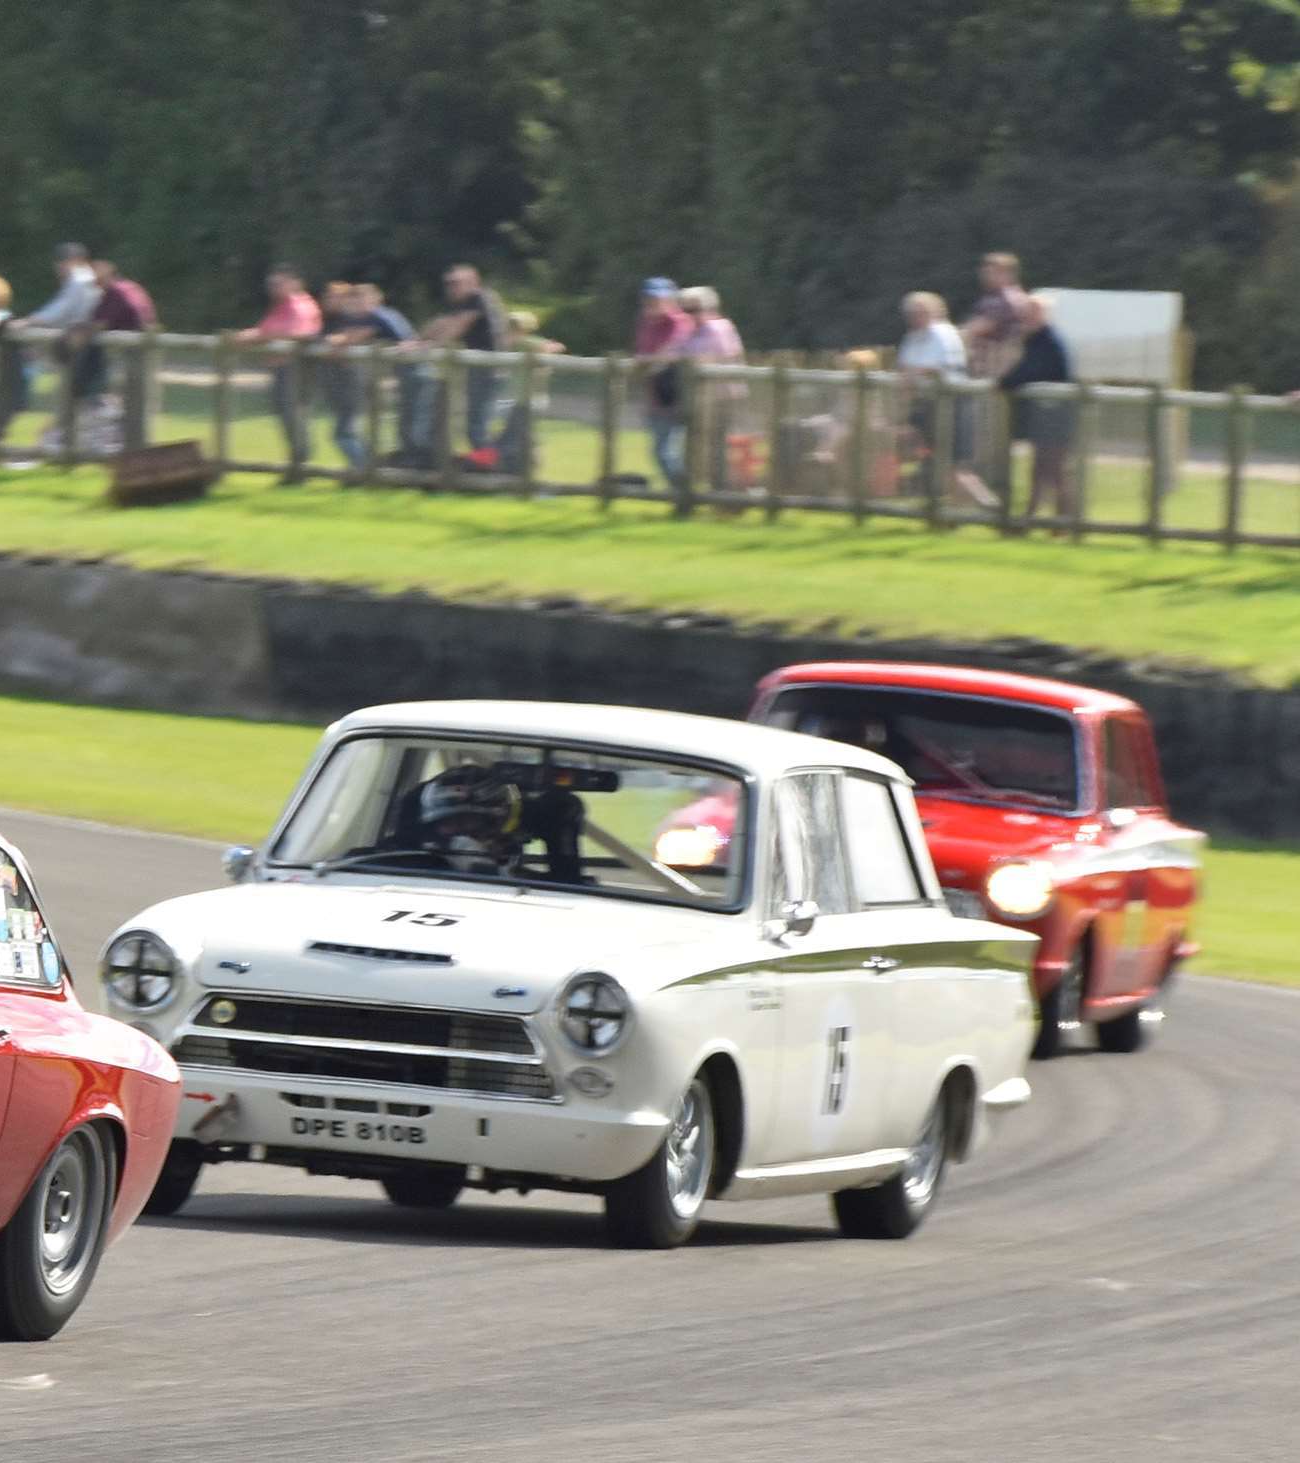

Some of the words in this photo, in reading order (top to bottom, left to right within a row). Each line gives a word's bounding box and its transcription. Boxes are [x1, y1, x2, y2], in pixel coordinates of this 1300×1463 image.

[381, 909, 466, 927] 15
[291, 1116, 347, 1138] DPE
[355, 1122, 428, 1144] 810B
